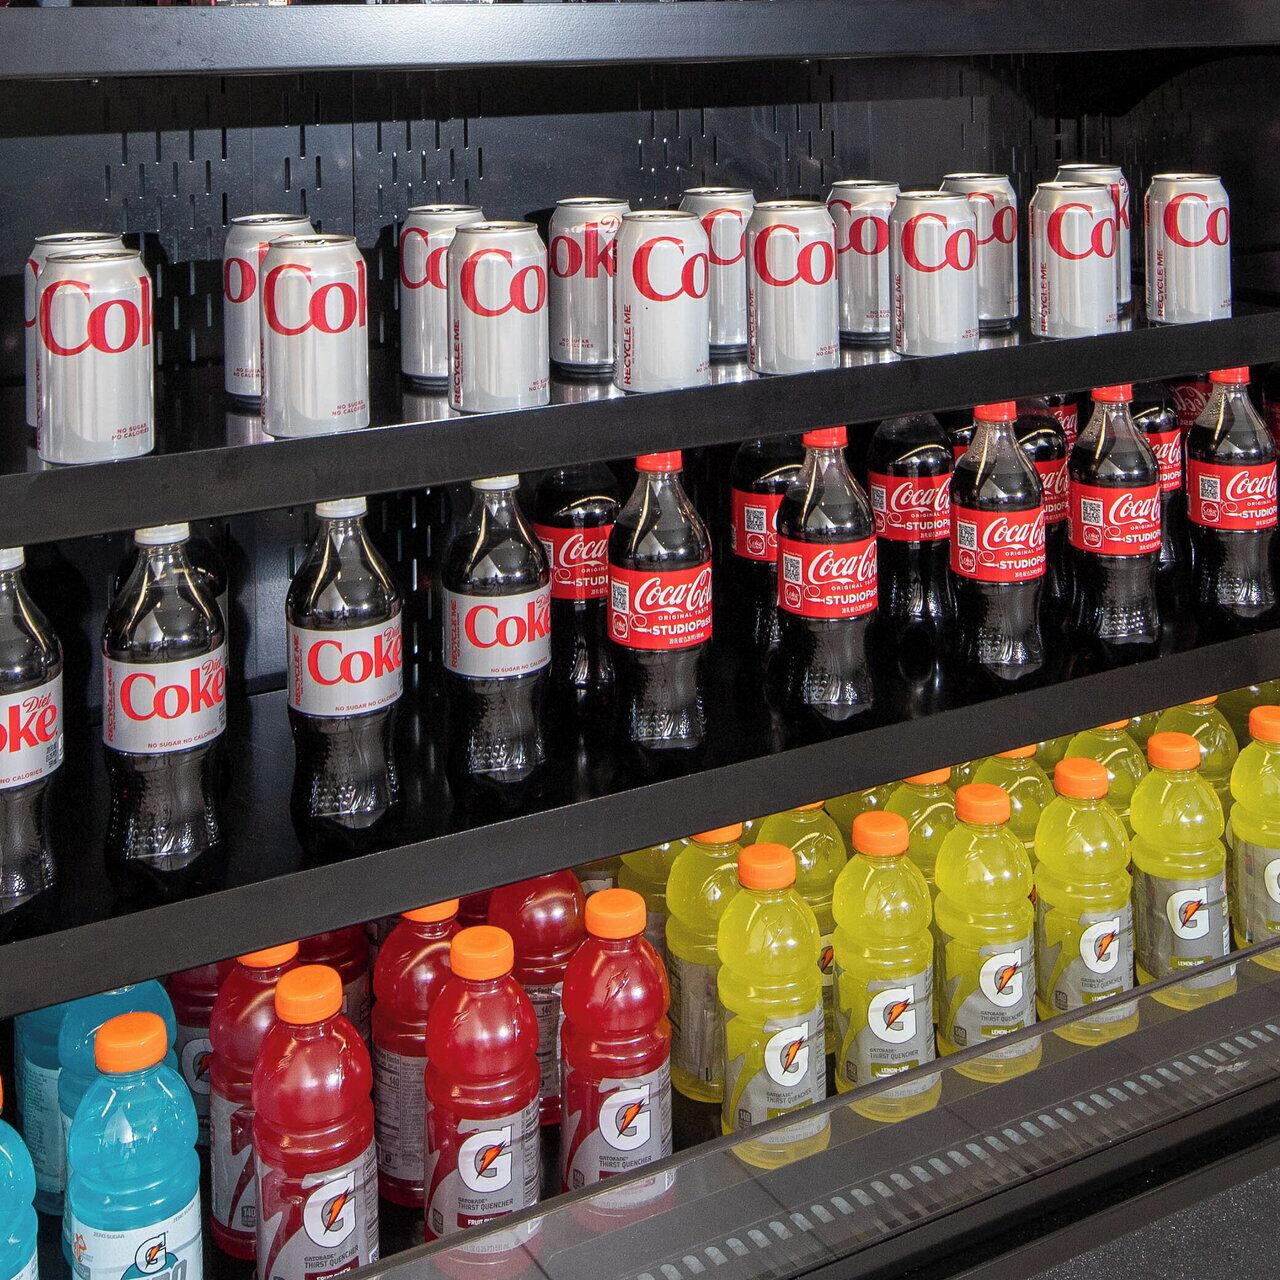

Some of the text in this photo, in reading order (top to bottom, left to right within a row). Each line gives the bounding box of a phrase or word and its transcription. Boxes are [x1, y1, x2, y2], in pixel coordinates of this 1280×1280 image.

[658, 612, 692, 621] ORIGINAL
[306, 633, 403, 686] Coke
[22, 692, 53, 716] Diet
[458, 1198, 514, 1211] THIRST QUENCHER
[468, 1218, 484, 1226] FRUIT
